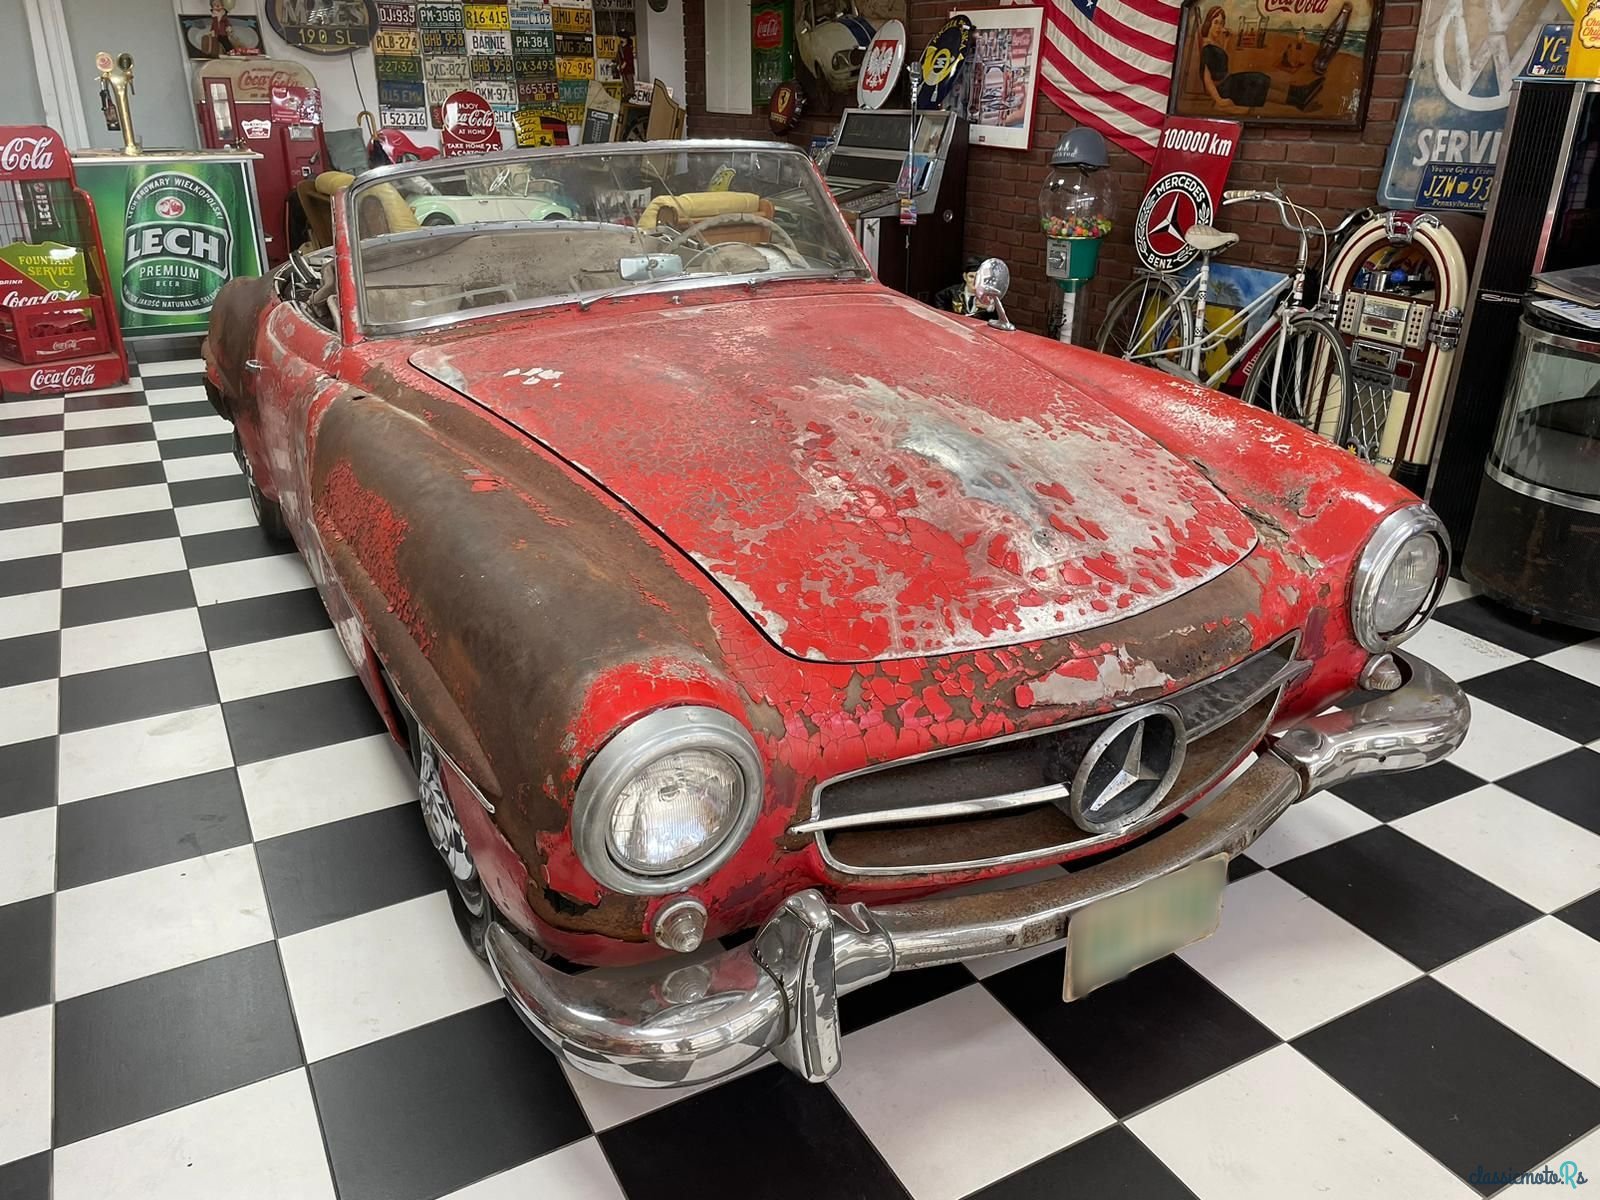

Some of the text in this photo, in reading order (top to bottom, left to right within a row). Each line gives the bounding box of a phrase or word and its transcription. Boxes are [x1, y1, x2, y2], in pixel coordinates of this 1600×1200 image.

[575, 12, 590, 25] 454
[299, 28, 356, 45] 190 SL
[472, 36, 506, 49] BARNIE
[382, 112, 388, 124] T
[390, 113, 407, 125] 523
[408, 113, 425, 126] 216
[1163, 128, 1232, 157] 100000 km
[1412, 128, 1503, 166] SERVI
[1156, 176, 1206, 202] MERCEDES
[1424, 175, 1493, 201] JZW 93
[174, 178, 224, 220] WIELKOPOLSKI
[128, 227, 219, 263] LECH
[18, 256, 74, 265] FOUNTAIN
[1147, 253, 1173, 269] BENZ
[27, 266, 76, 277] SERVICE
[140, 265, 199, 279] PREMIUM
[161, 298, 201, 308] NATURALNE
[30, 364, 96, 391] Coca-Cola
